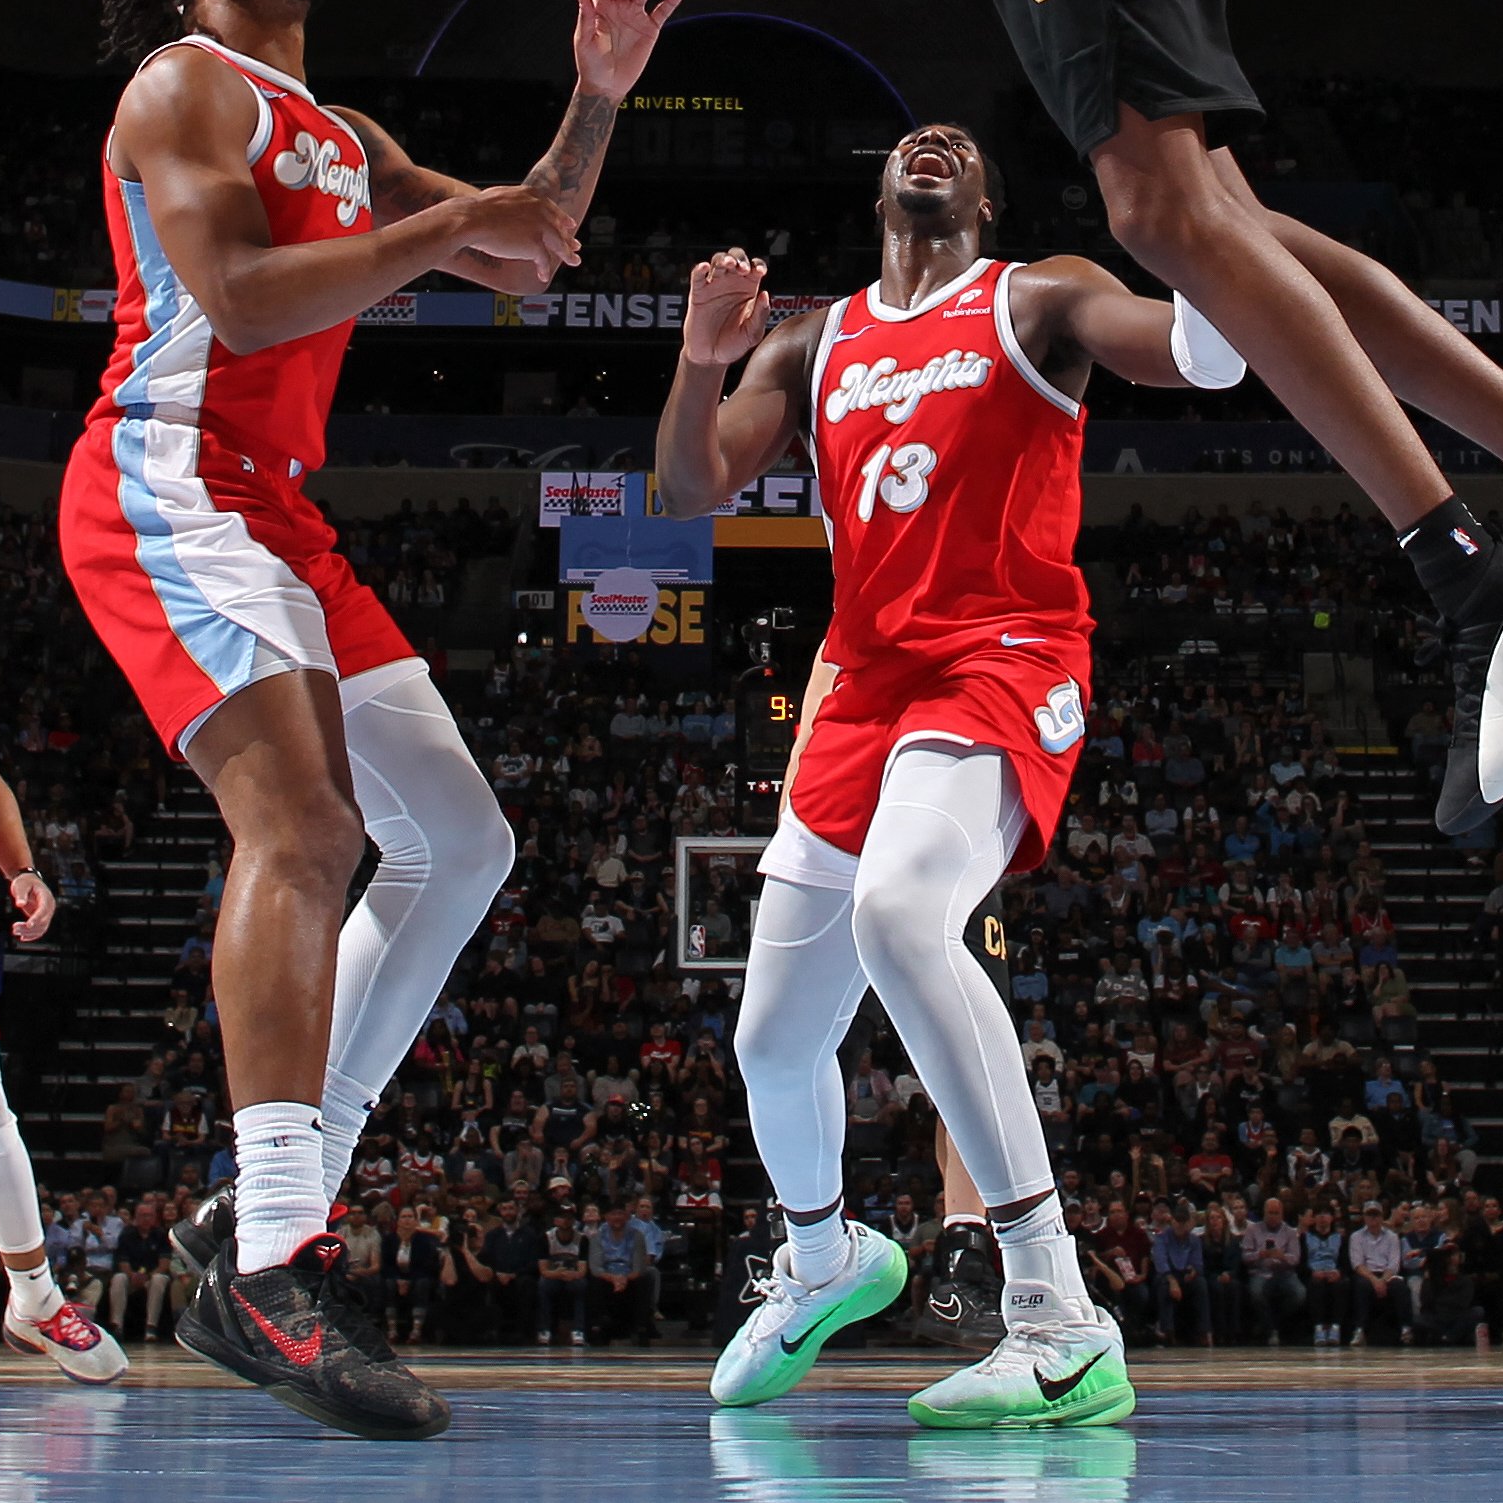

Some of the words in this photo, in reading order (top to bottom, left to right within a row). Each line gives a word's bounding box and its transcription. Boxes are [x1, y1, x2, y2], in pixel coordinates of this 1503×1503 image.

[634, 96, 686, 110] RIVER
[692, 97, 744, 111] STEEL
[273, 130, 372, 228] Memp
[942, 306, 991, 320] Robinhood
[824, 348, 994, 425] Memphis
[857, 441, 938, 524] 13
[566, 590, 705, 645] FSE
[590, 593, 648, 604] SealMaster
